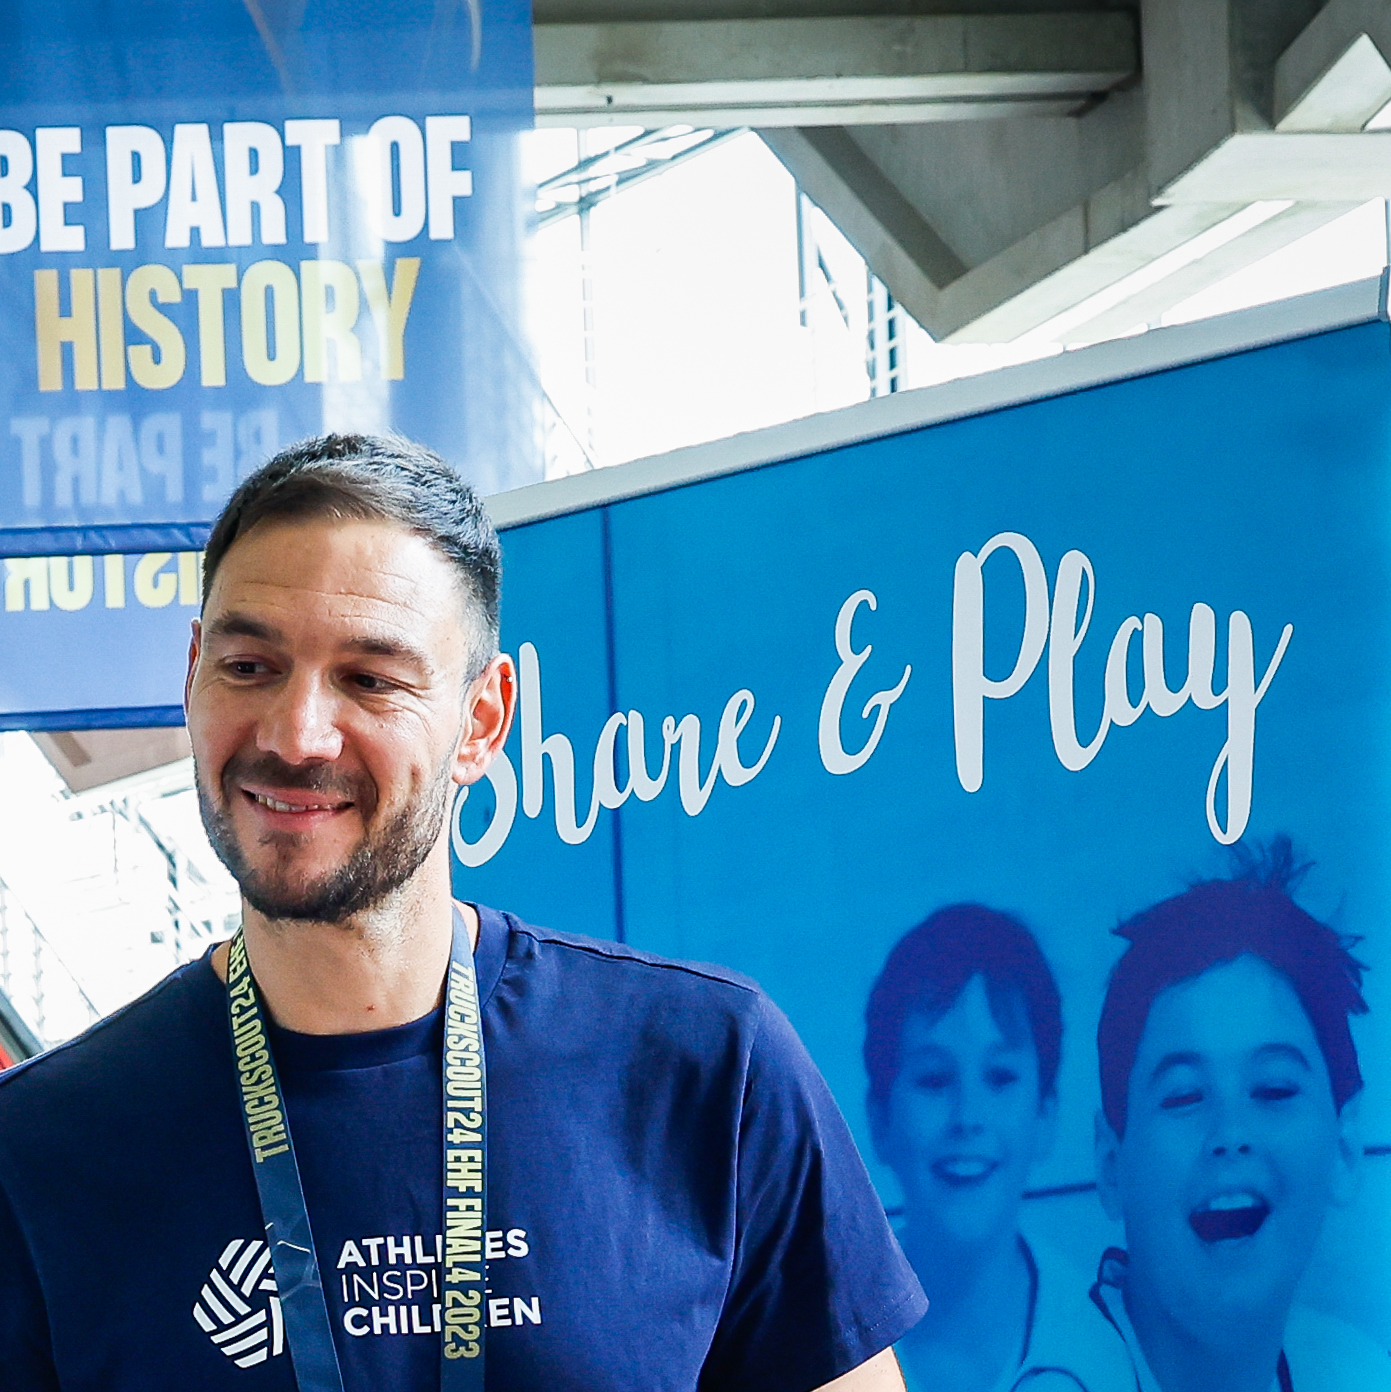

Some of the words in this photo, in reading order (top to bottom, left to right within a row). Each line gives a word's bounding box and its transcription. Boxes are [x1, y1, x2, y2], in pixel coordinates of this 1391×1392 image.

[105, 118, 340, 251] PART
[380, 114, 472, 241] OF
[33, 256, 420, 392] HISTORY
[818, 590, 911, 775] &
[952, 532, 1293, 845] Play
[230, 975, 290, 1164] TRUCKSCOUT24
[444, 960, 484, 1144] TRUCKSCOUT24
[445, 1149, 484, 1193] EHF
[336, 1228, 530, 1269] ATHLES
[444, 1199, 484, 1283] FINAL4
[343, 1296, 542, 1337] CHILEN
[444, 1290, 482, 1360] 2023
